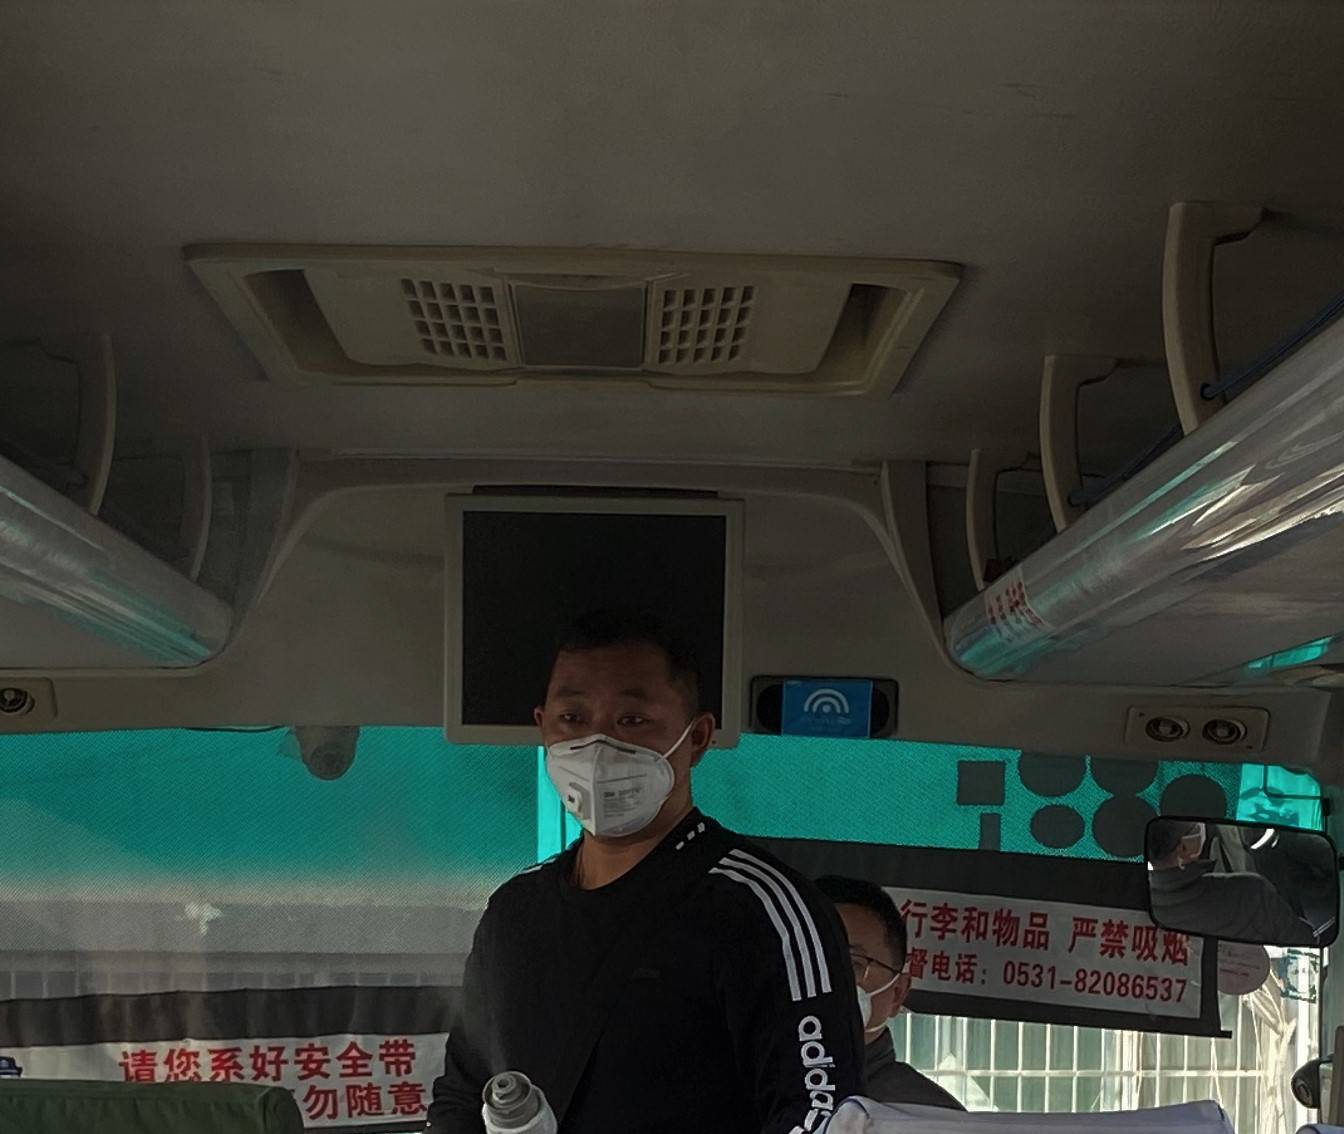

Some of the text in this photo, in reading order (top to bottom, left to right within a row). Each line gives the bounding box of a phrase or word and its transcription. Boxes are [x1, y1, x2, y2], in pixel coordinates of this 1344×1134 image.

[901, 896, 1051, 952] 行李和物品
[1067, 914, 1191, 967] 严禁吸烟
[119, 1038, 417, 1083] 请您系好安全带
[287, 1081, 429, 1122] 勿随意
